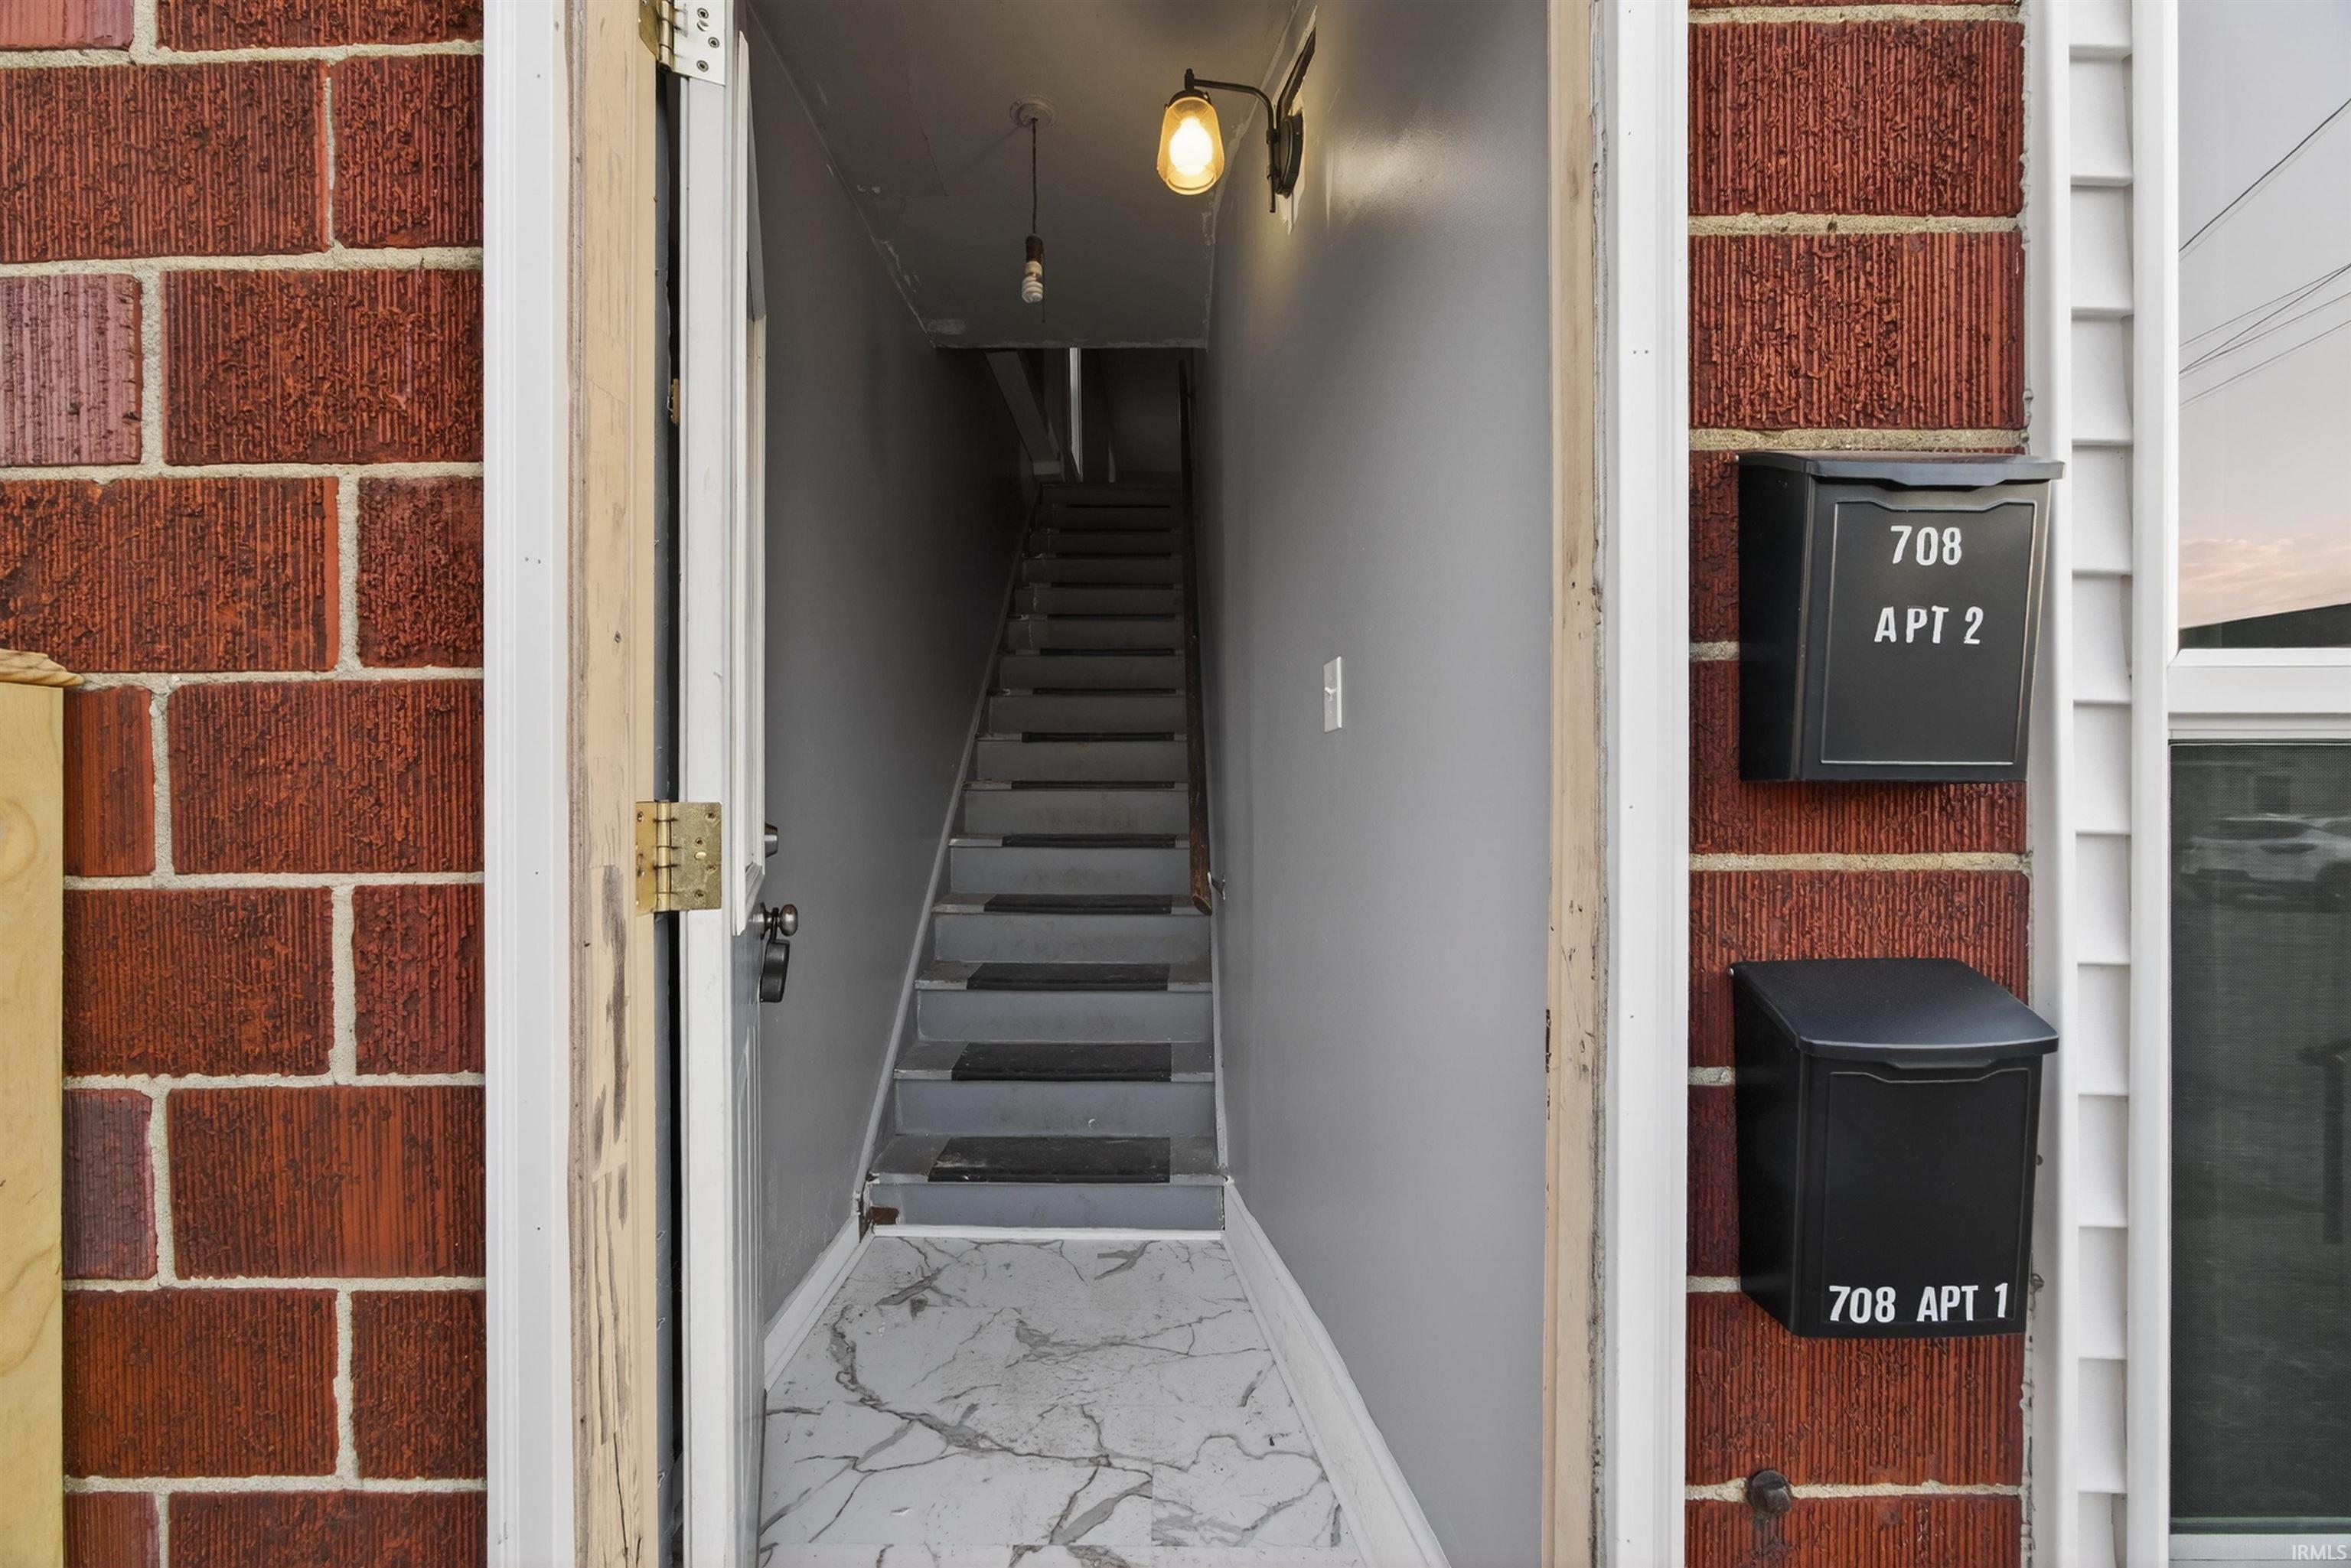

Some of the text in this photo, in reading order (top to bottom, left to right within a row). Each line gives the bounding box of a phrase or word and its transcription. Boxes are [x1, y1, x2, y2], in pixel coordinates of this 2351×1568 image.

[1891, 526, 1962, 566] 708
[1874, 605, 1984, 644] APT 2
[1829, 1283, 2008, 1323] 708 APT 1
